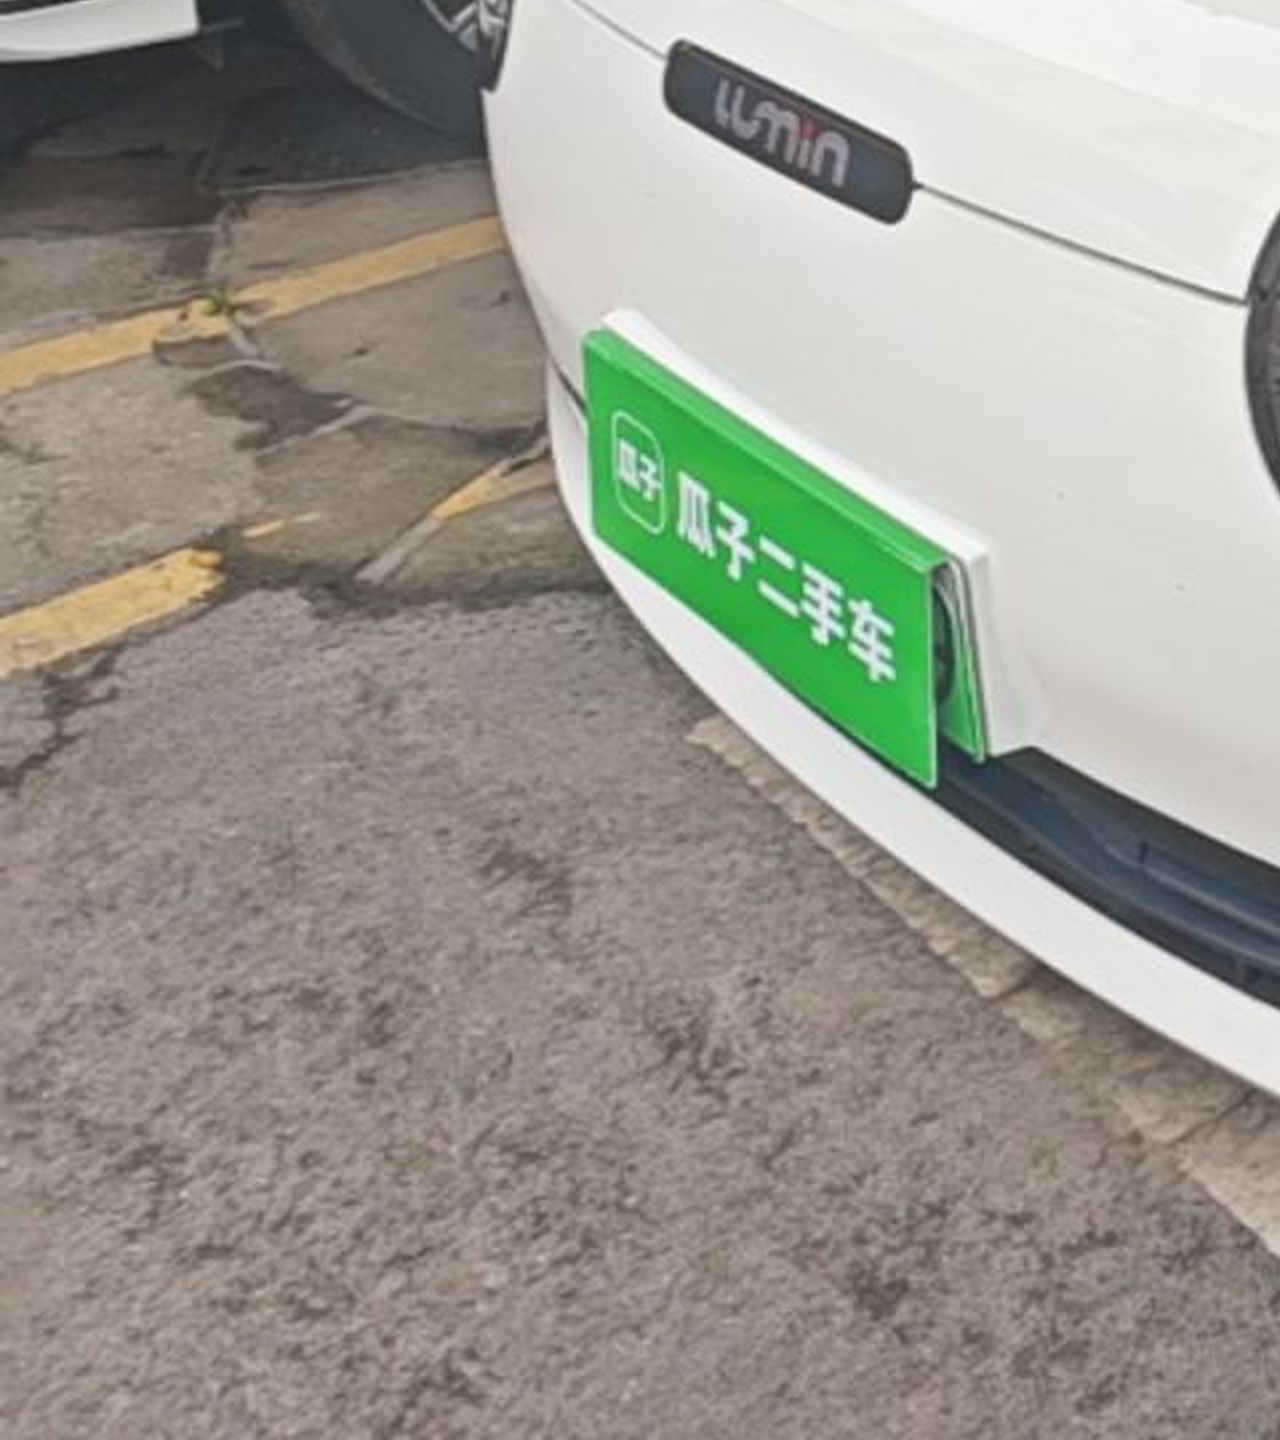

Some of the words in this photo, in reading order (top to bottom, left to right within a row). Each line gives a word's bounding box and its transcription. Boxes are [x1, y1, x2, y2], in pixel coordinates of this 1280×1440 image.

[617, 437, 661, 503] 瓜子
[675, 469, 897, 684] 瓜子二手车
